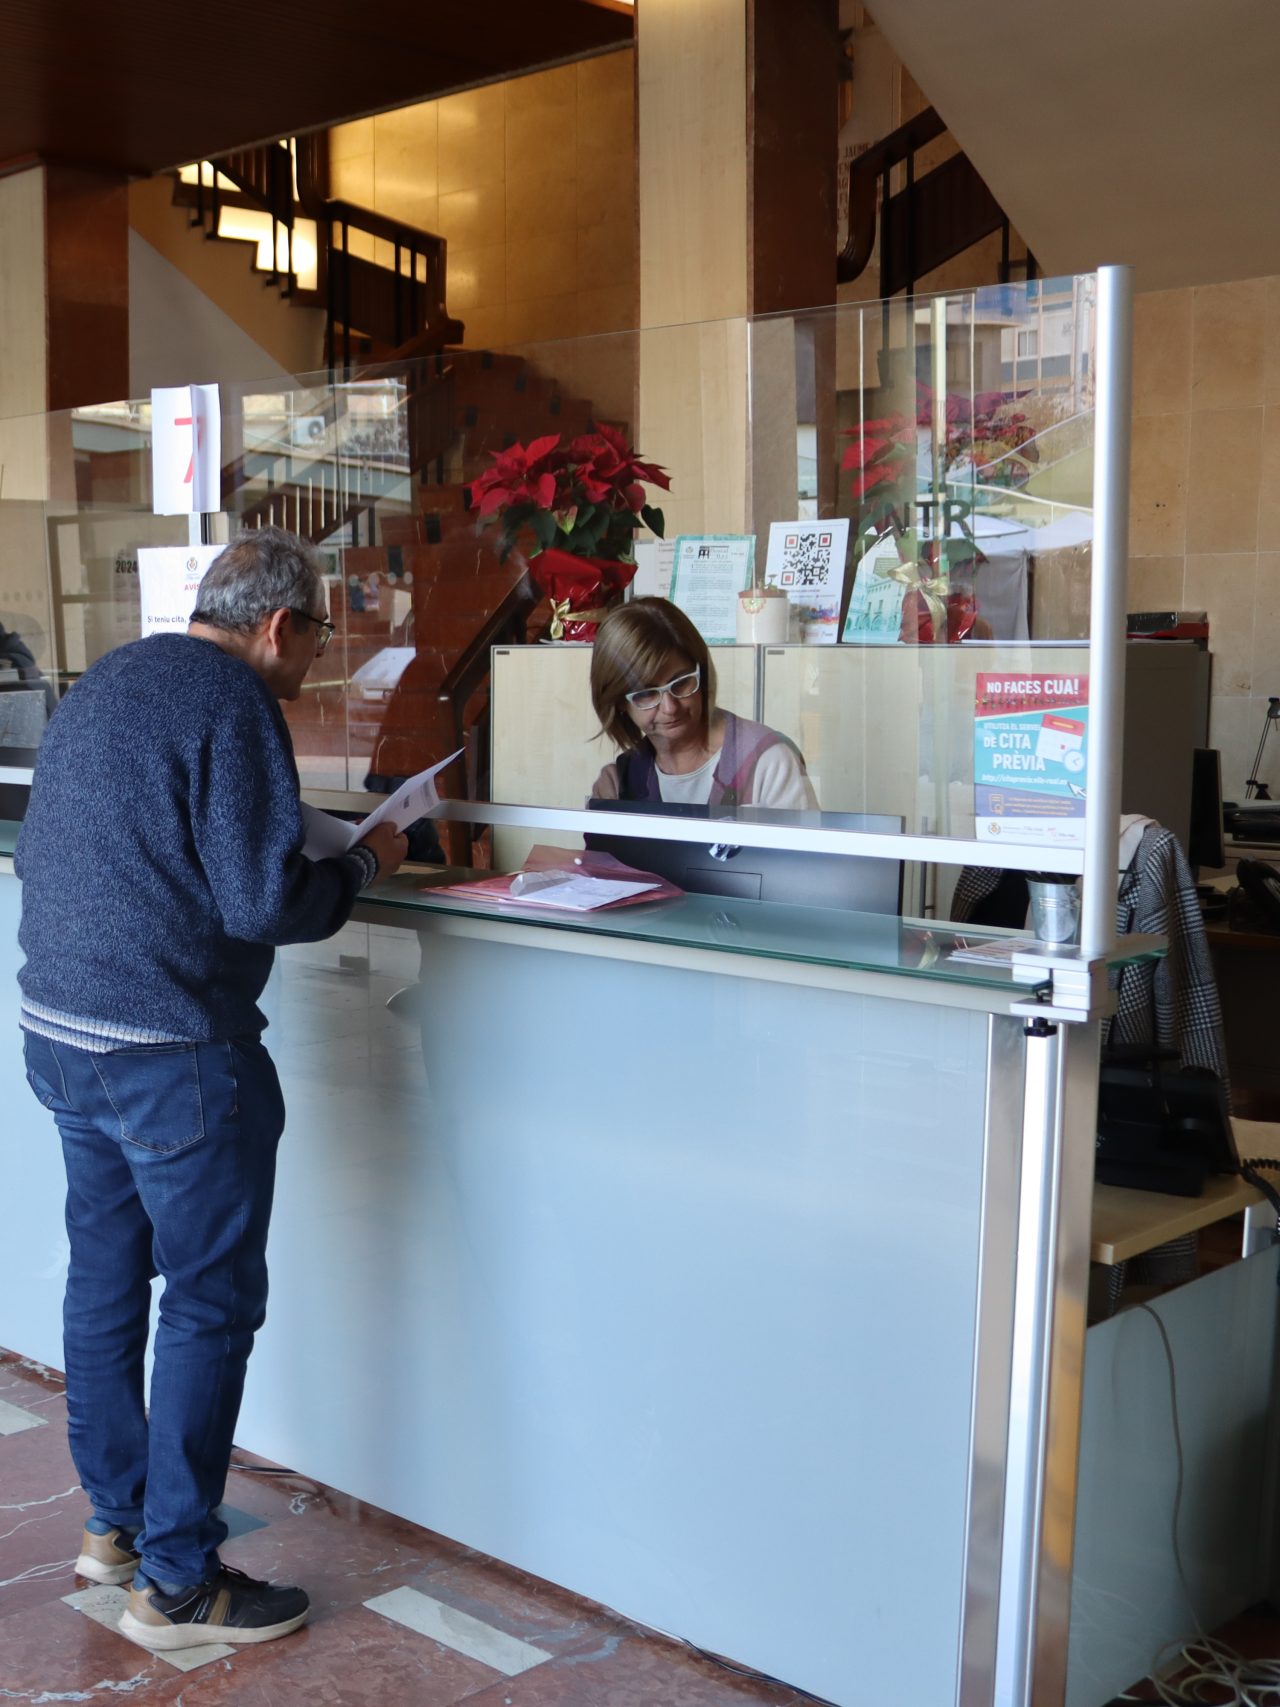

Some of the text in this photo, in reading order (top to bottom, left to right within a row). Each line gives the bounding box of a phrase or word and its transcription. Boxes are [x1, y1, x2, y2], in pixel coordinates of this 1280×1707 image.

[174, 417, 204, 483] 7
[115, 560, 138, 573] 2024
[987, 679, 1079, 695] NO FACES CUA!
[984, 733, 1031, 749] DE CITA
[993, 750, 1045, 771] PRÈVIA
